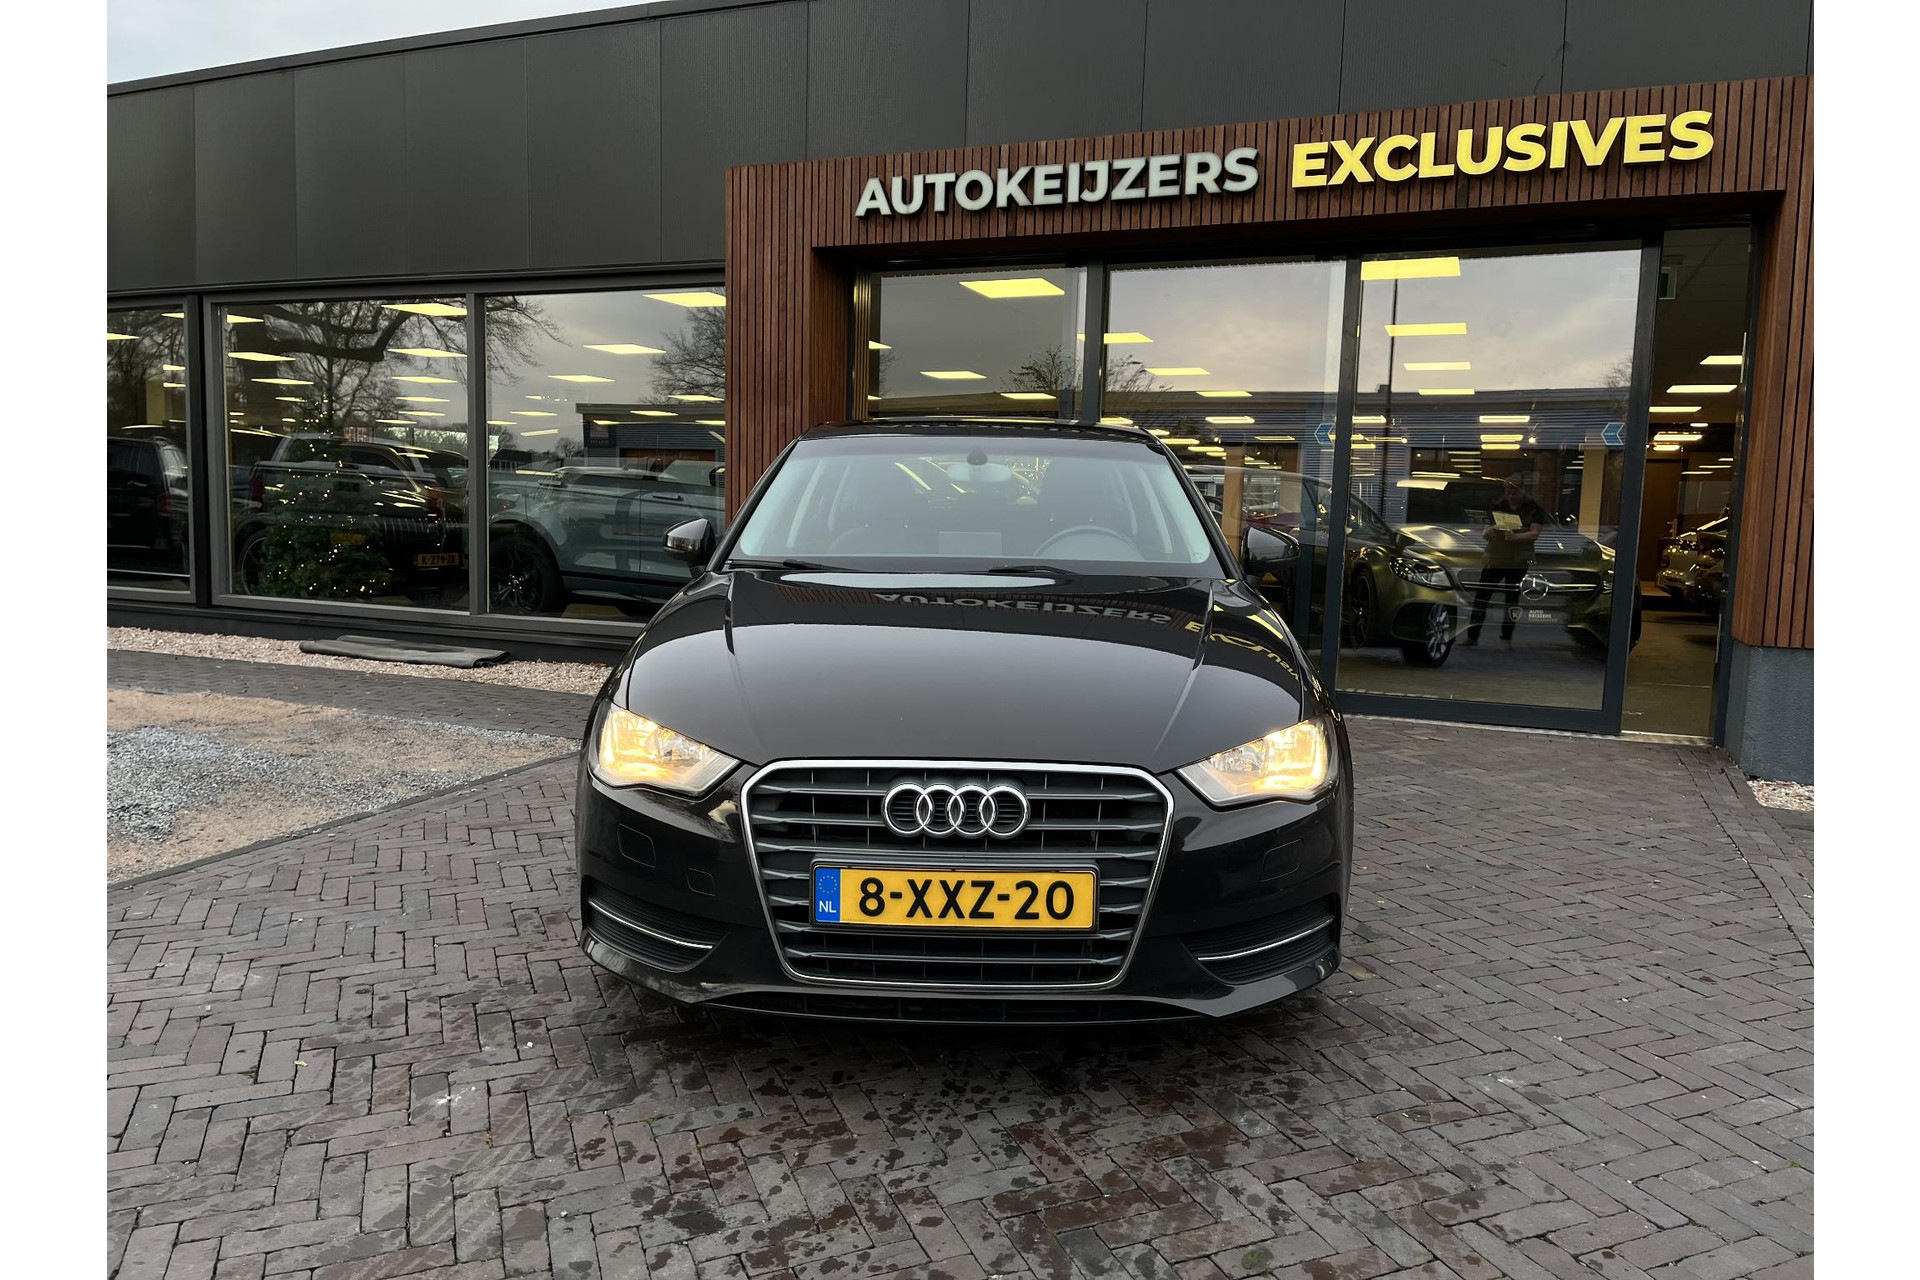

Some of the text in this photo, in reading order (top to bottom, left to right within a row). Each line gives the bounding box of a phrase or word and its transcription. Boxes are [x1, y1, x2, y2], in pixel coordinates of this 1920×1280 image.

[854, 110, 1714, 217] AUTOKEIJZERS EXCLUSIVES
[818, 900, 837, 914] NL
[859, 877, 1075, 920] 8-XXZ-20
